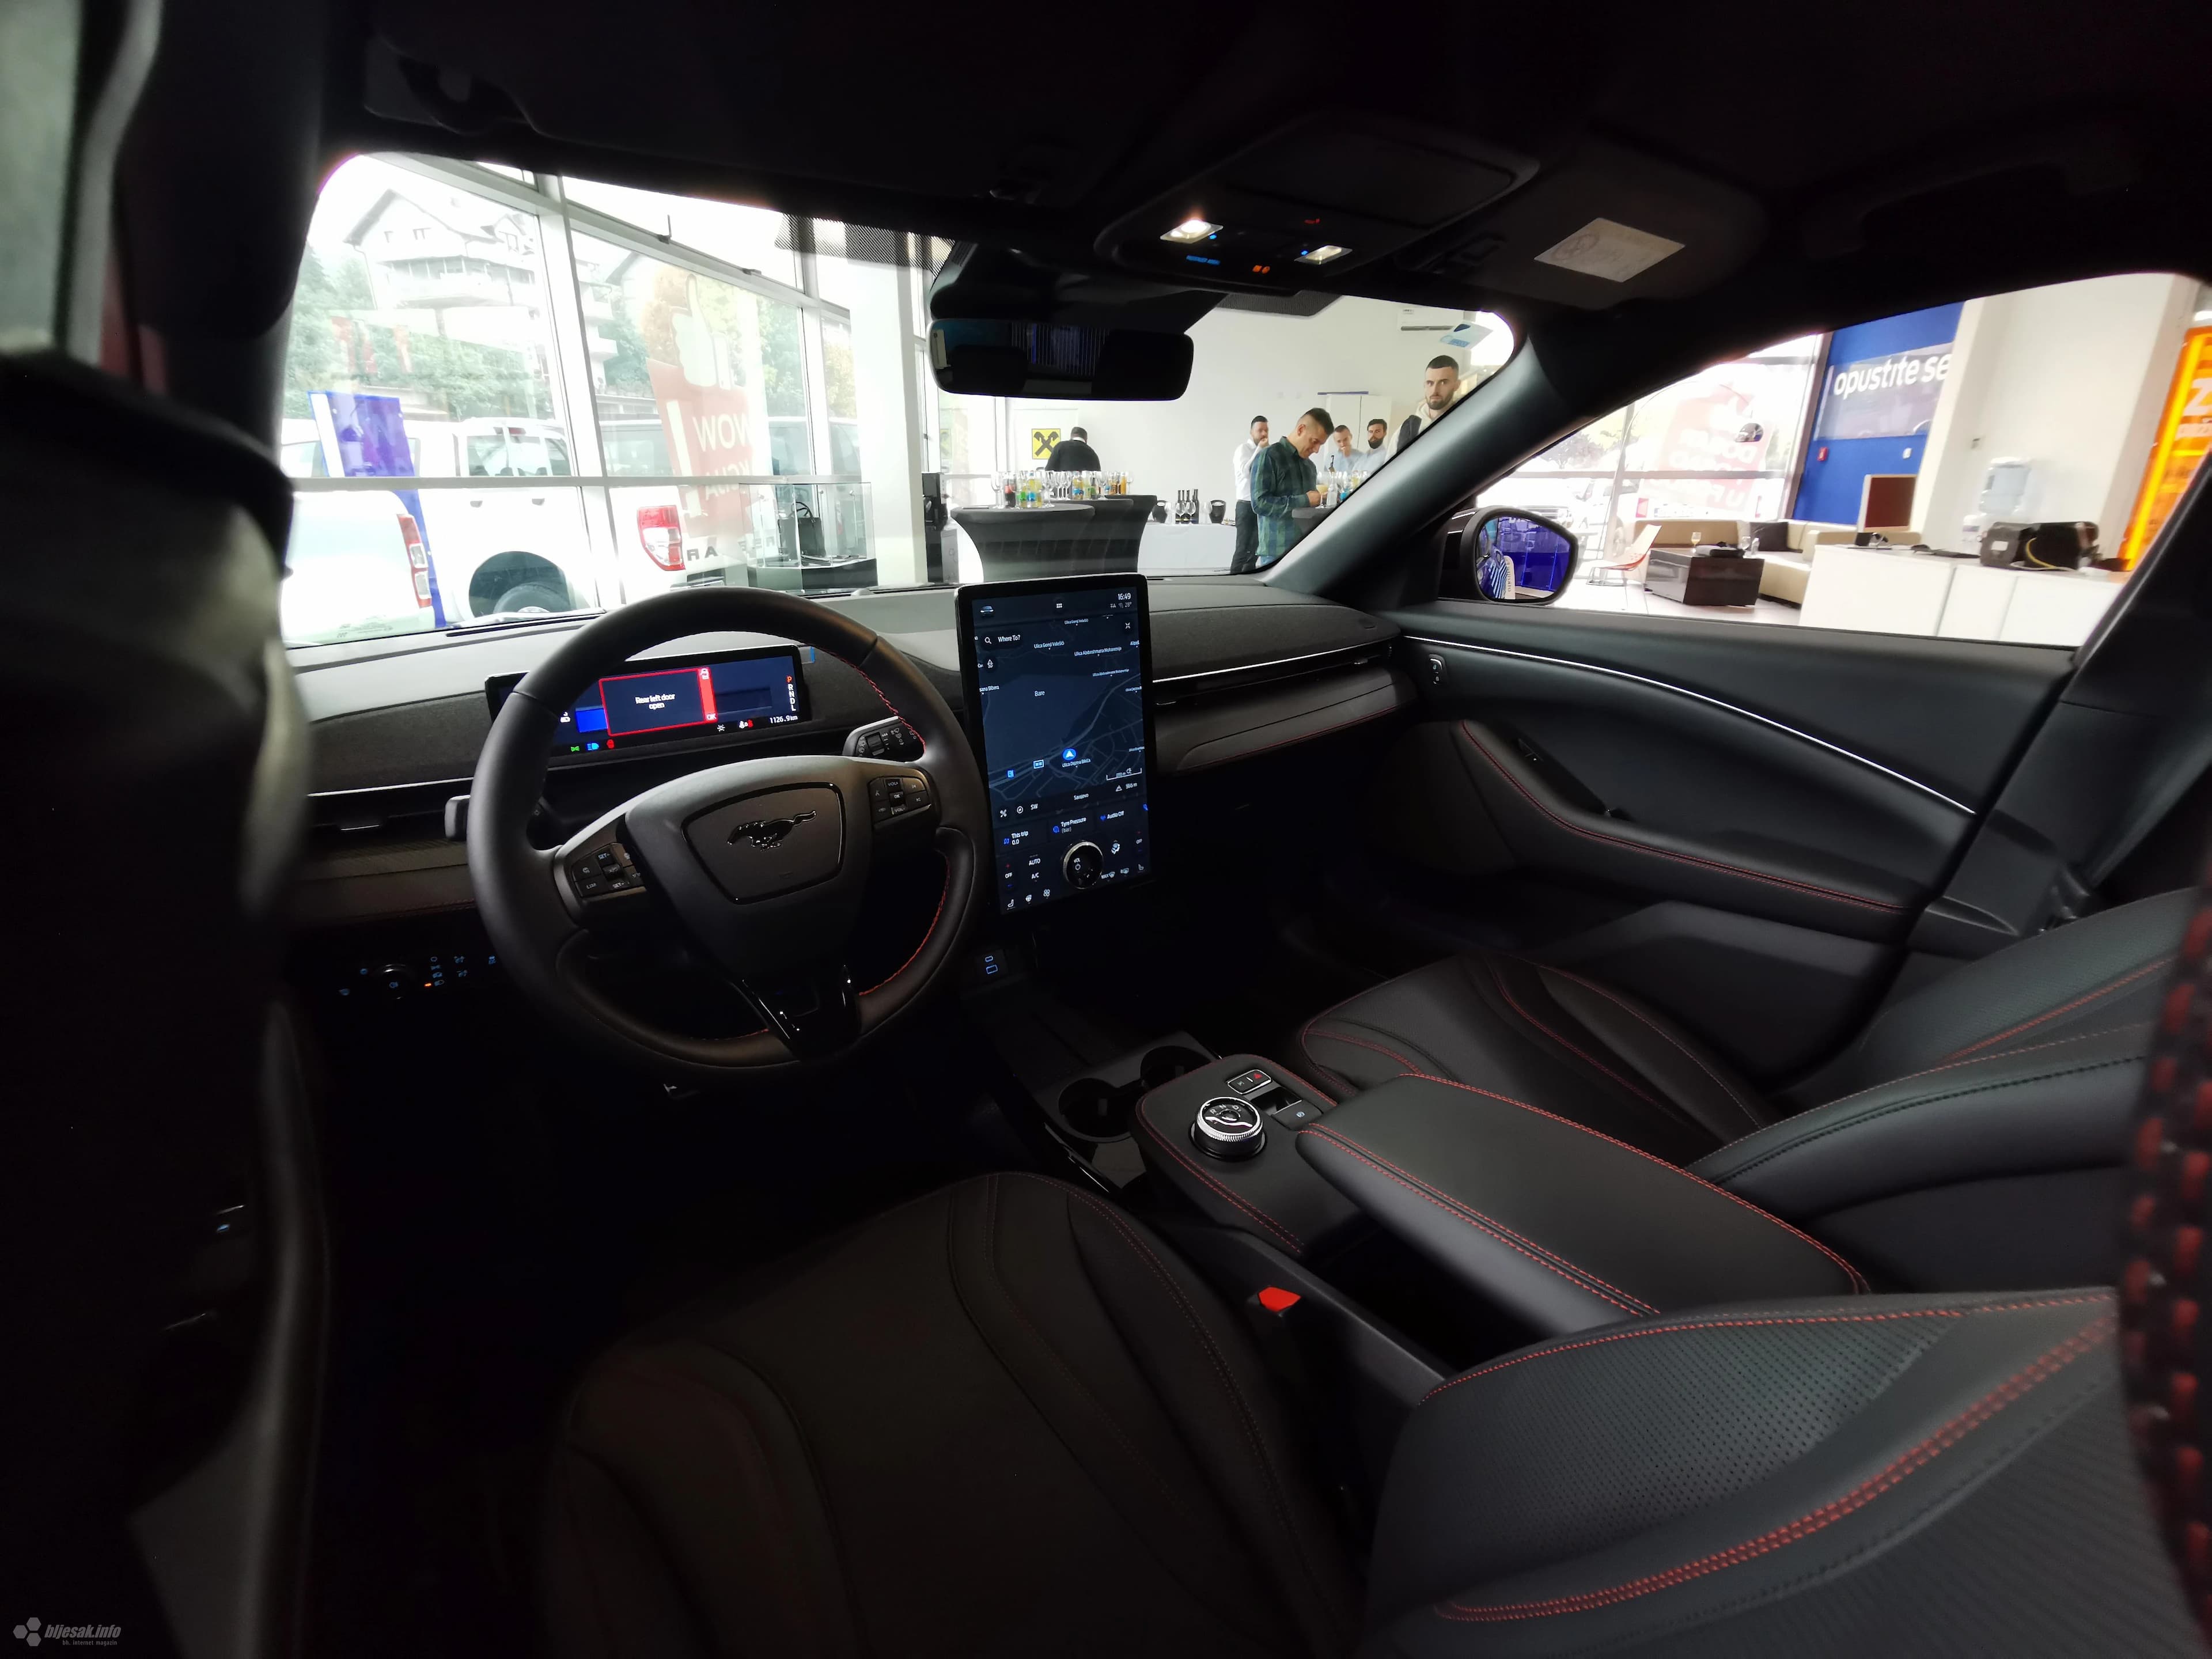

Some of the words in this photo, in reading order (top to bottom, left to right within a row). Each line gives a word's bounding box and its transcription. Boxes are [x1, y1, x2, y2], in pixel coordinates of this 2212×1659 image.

[787, 675, 793, 683] P
[635, 695, 650, 704] Rear
[649, 702, 665, 710] open
[1028, 858, 1041, 866] AUTO
